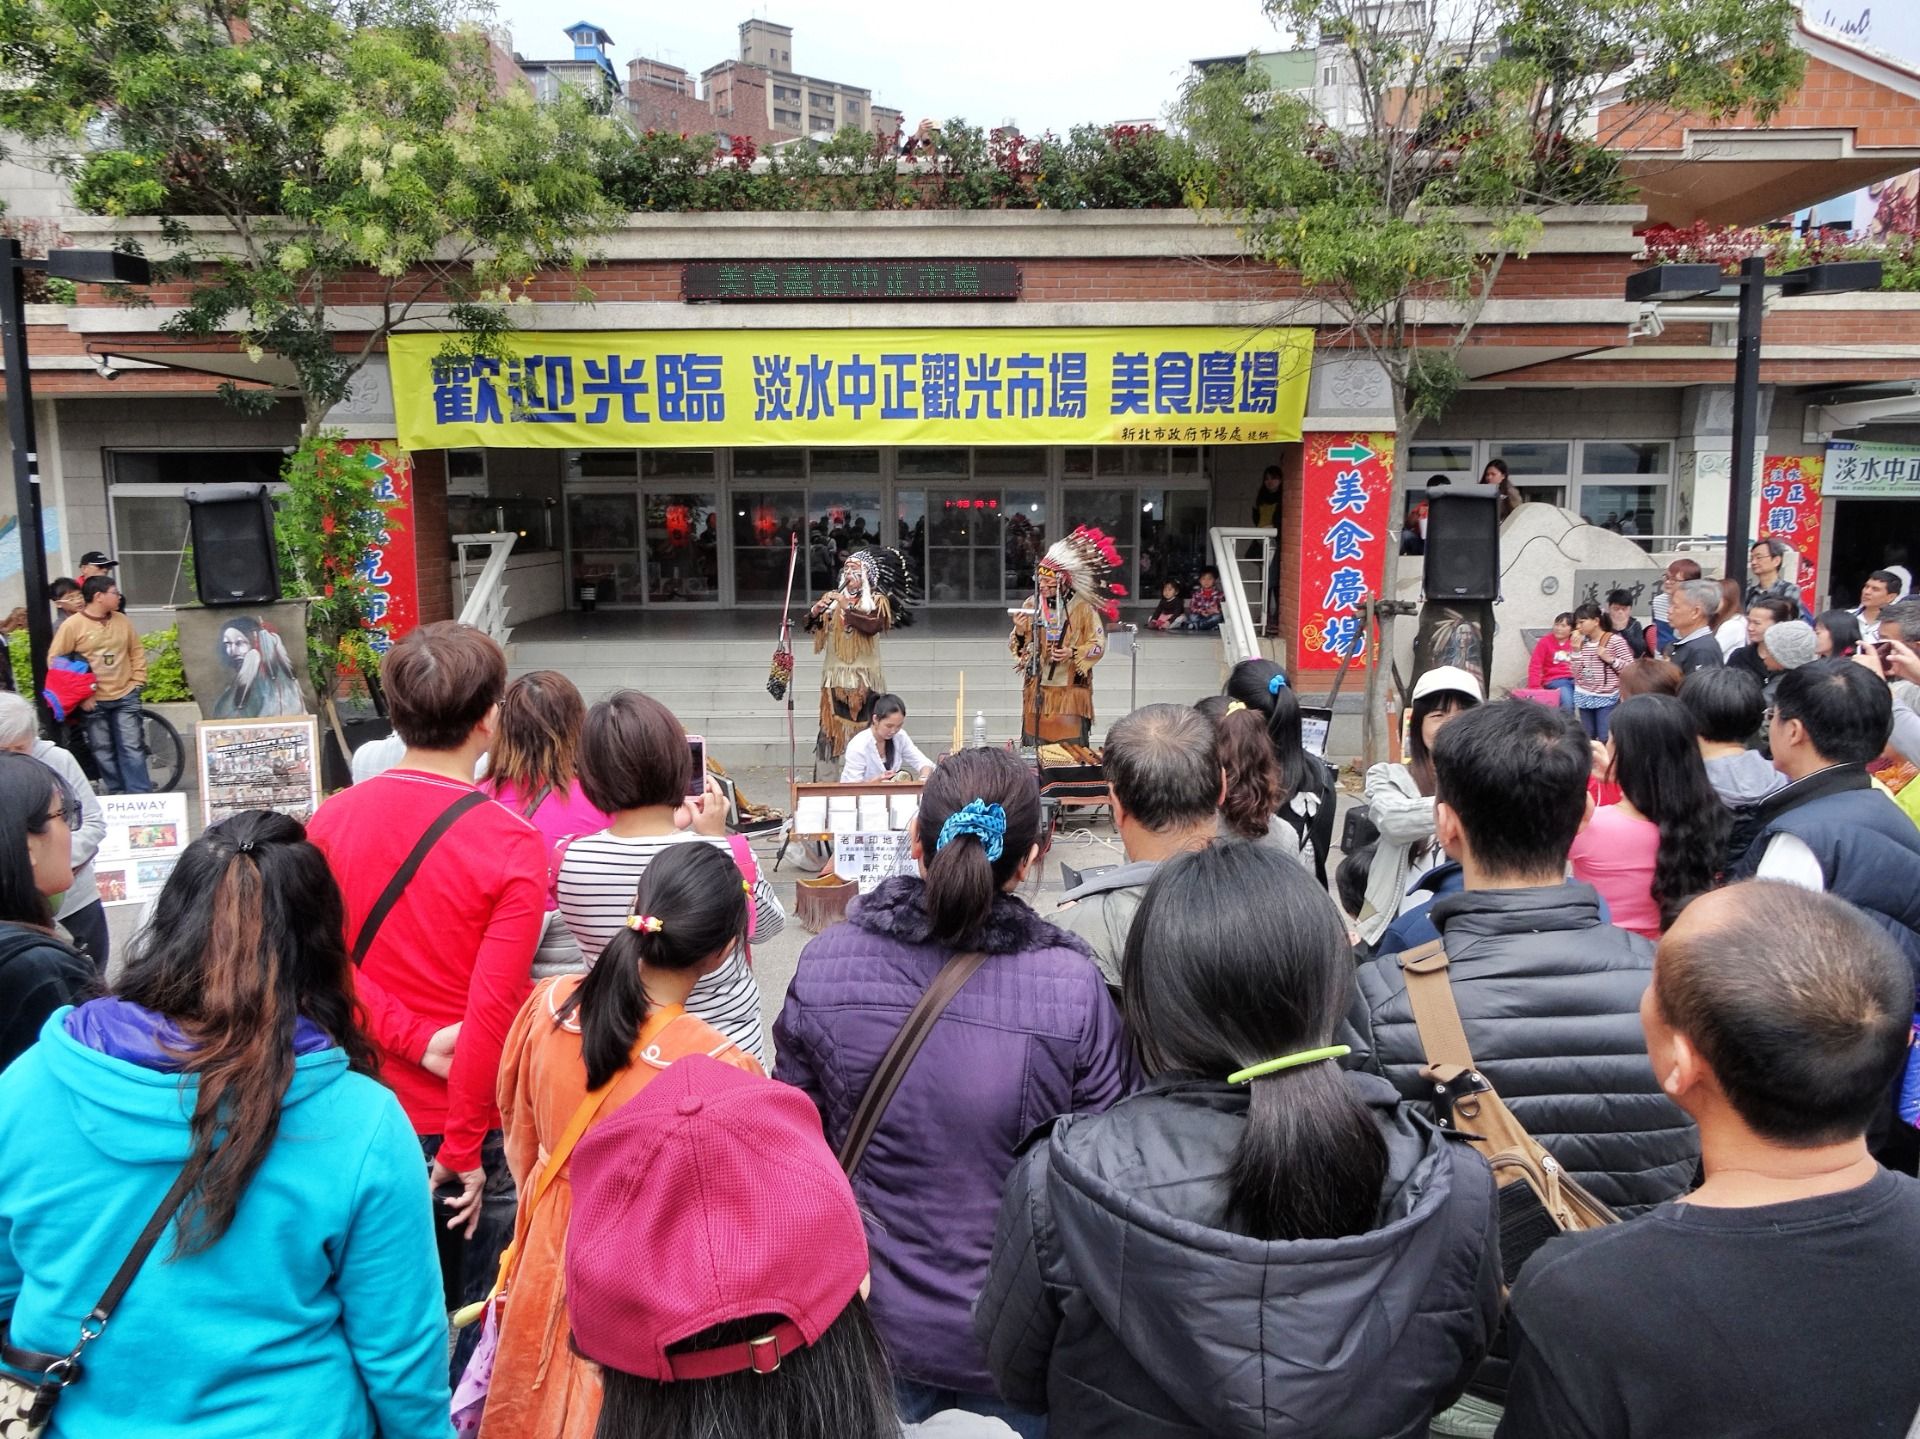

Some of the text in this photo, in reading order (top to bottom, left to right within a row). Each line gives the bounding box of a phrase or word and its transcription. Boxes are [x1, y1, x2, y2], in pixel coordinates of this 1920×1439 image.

[431, 350, 1280, 425] 歡迎光臨 淡水中正觀光市場 美食廣場
[1121, 427, 1242, 442] 新北市政府市場處
[1835, 457, 1920, 482] 淡水中正
[1763, 484, 1806, 504] 中正
[1323, 469, 1375, 659] 美食廣場
[107, 800, 167, 812] PHAWAY
